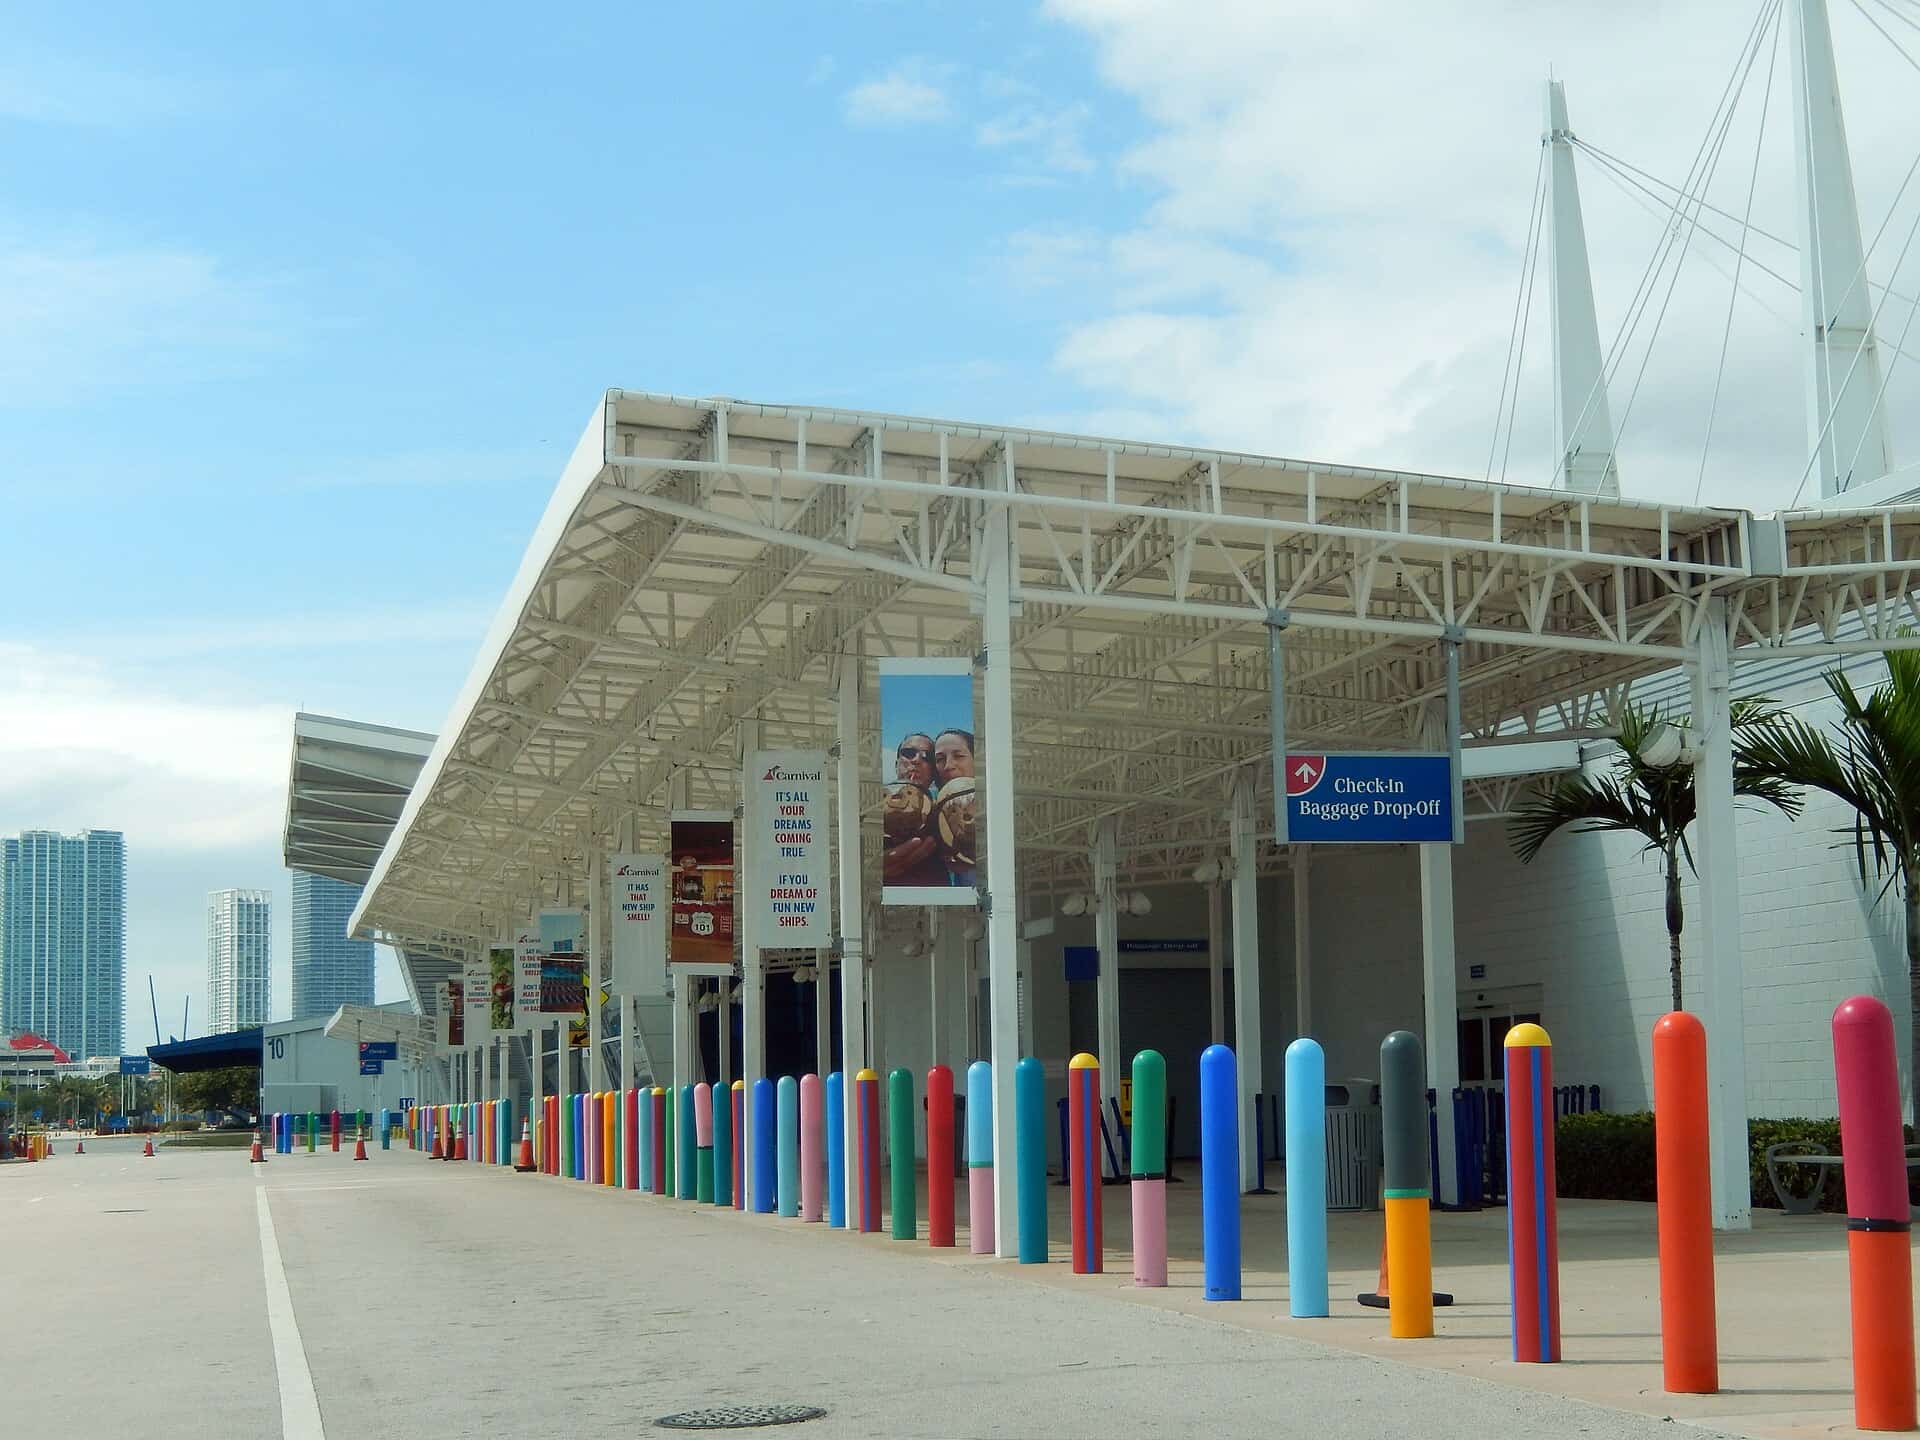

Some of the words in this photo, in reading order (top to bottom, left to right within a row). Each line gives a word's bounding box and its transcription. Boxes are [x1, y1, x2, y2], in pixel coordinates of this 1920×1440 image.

[775, 771, 821, 781] Carnival
[1334, 777, 1404, 793] Check-In
[775, 792, 791, 802] IT'S
[793, 792, 809, 802] ALL
[779, 806, 805, 816] YOUR
[1300, 800, 1369, 820] Baggage
[1374, 799, 1441, 819] Drop-Off
[774, 820, 812, 830] DREAMS
[775, 833, 812, 843] COMING
[778, 874, 787, 884] IF
[789, 874, 808, 884] YOU
[770, 888, 803, 899] DREAM
[805, 888, 818, 899] OF
[773, 902, 791, 913] FUN
[793, 902, 815, 913] NEW
[627, 913, 650, 921] SMELL!
[778, 916, 809, 927] SHIPS.
[695, 923, 710, 932] 101
[268, 1038, 284, 1060] 10
